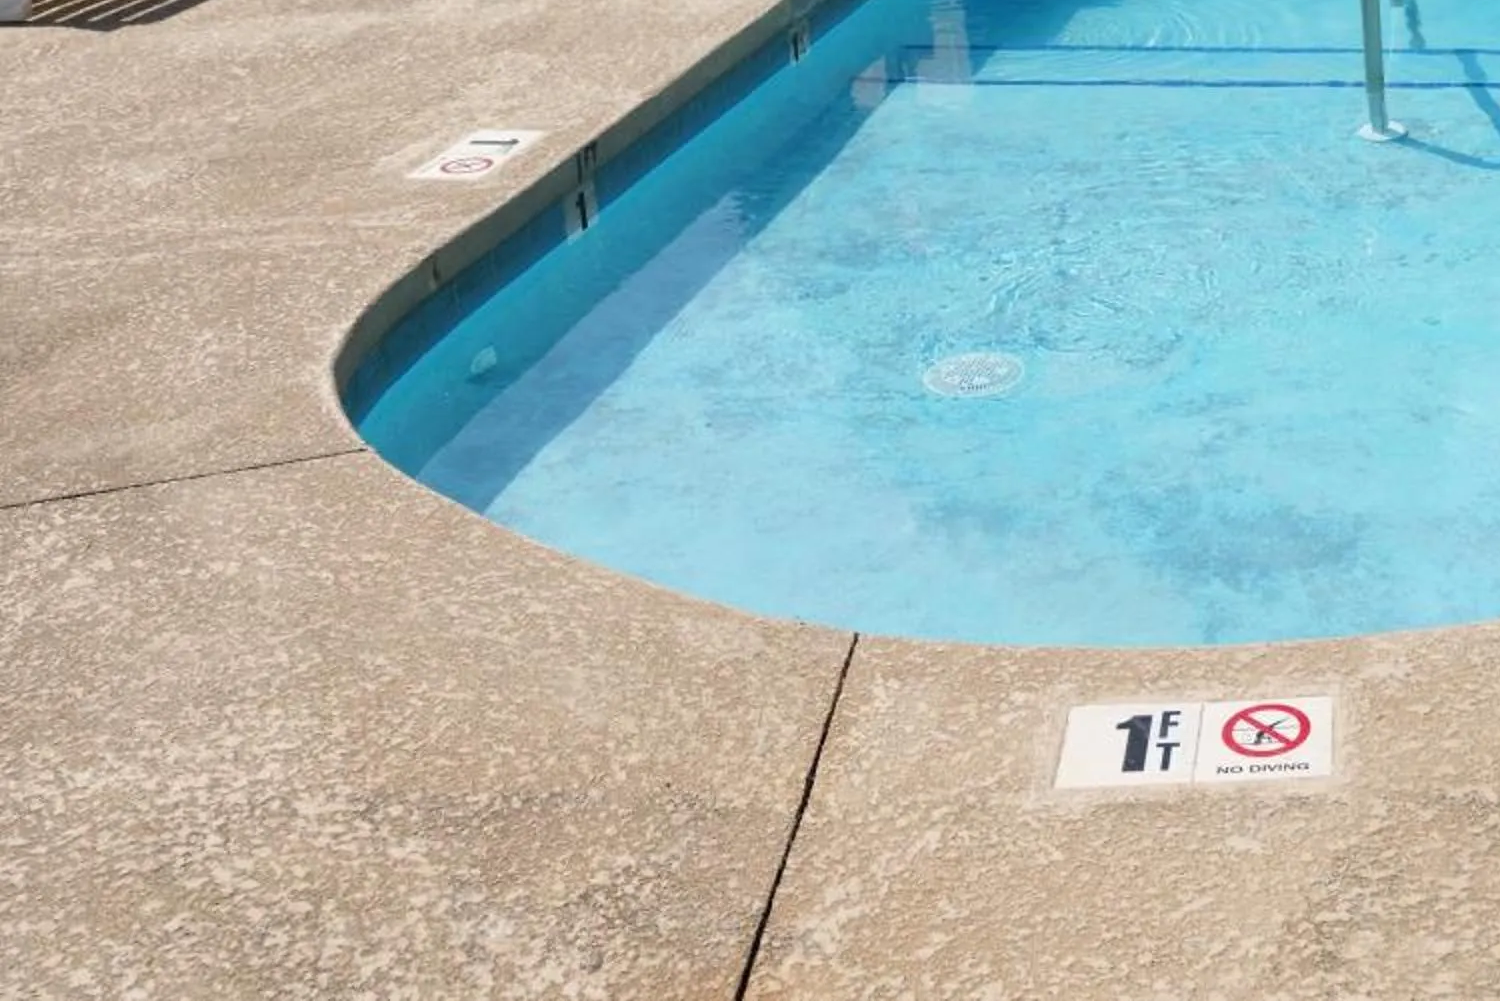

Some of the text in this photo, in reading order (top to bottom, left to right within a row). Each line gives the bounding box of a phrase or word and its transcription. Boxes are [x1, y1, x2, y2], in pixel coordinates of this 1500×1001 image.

[1115, 714, 1153, 773] 1
[1216, 762, 1310, 775] NO DIVING
